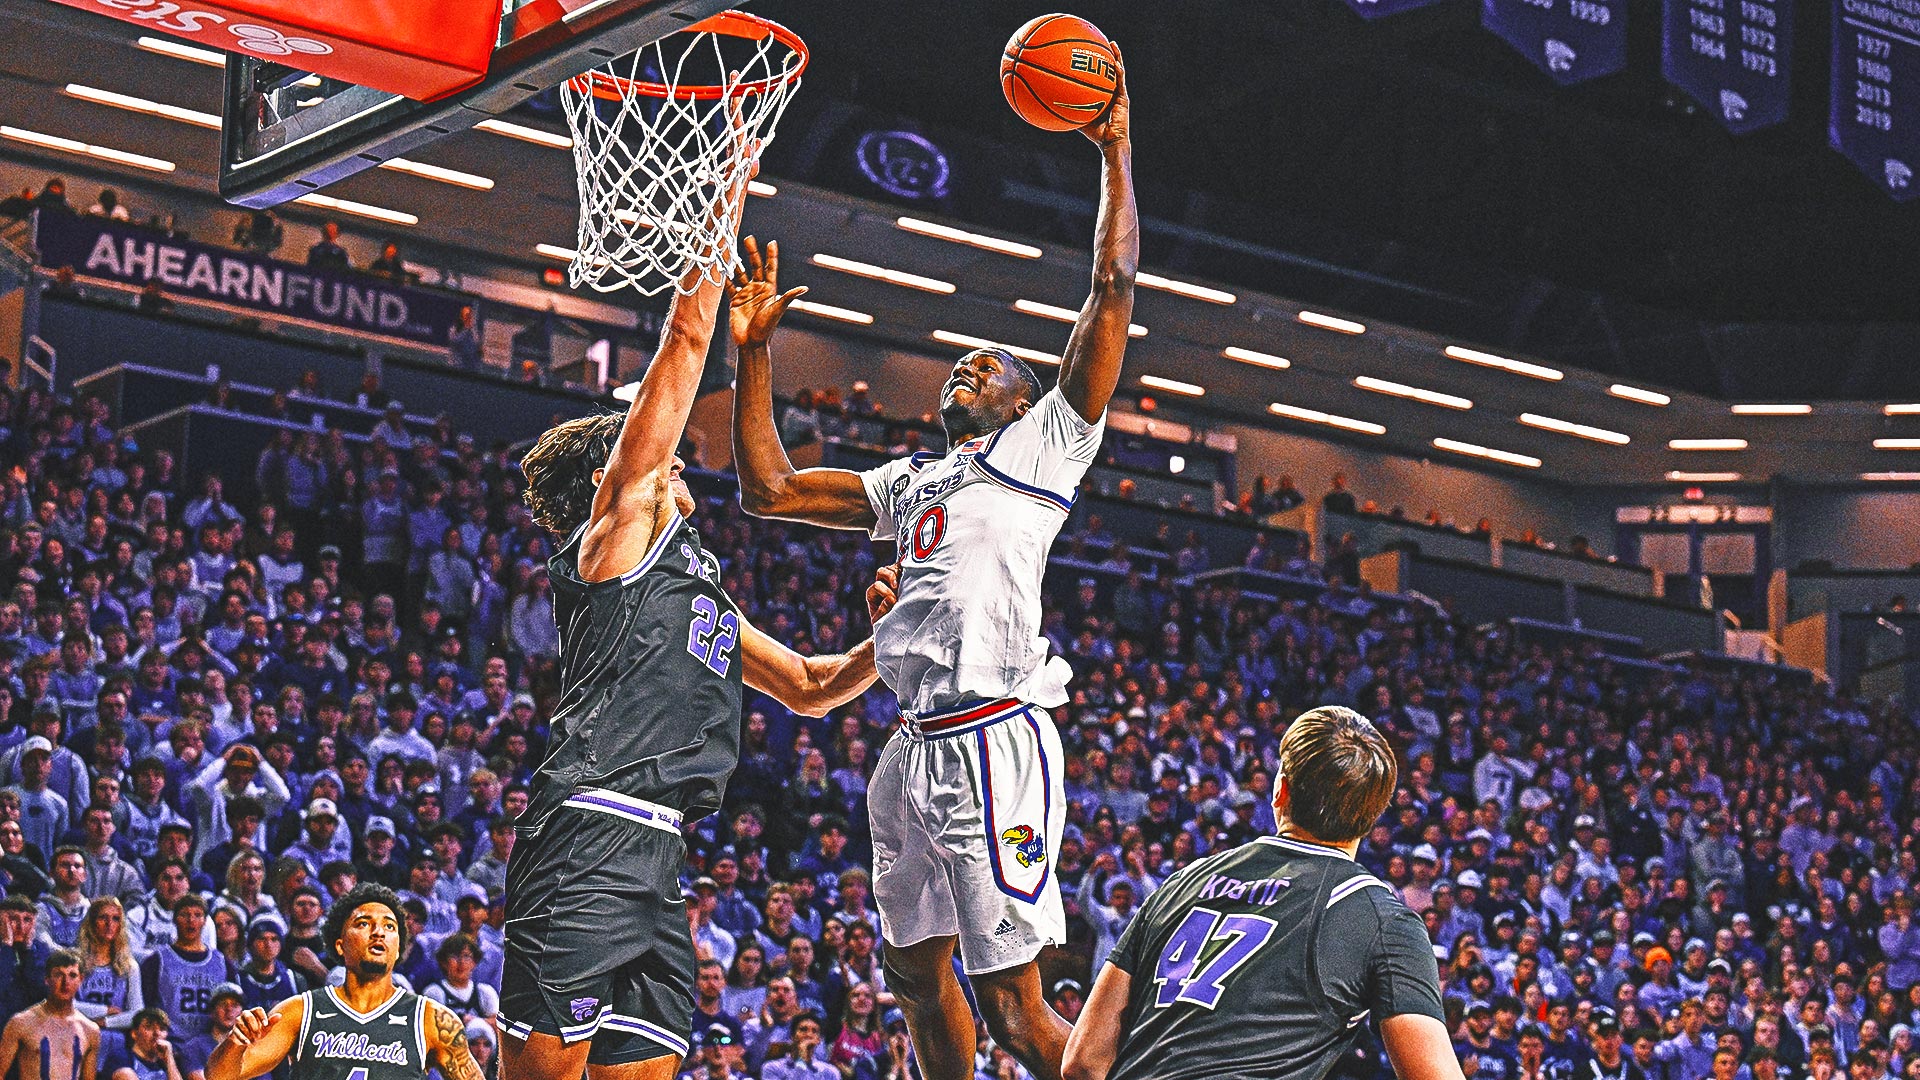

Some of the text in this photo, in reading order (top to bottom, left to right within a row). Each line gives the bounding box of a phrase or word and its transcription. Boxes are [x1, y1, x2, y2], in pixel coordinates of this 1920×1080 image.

[1070, 53, 1118, 84] ELITE
[686, 593, 741, 680] 22
[1027, 842, 1038, 855] KU
[1153, 905, 1279, 1011] 47
[312, 1030, 408, 1065] Wildcats
